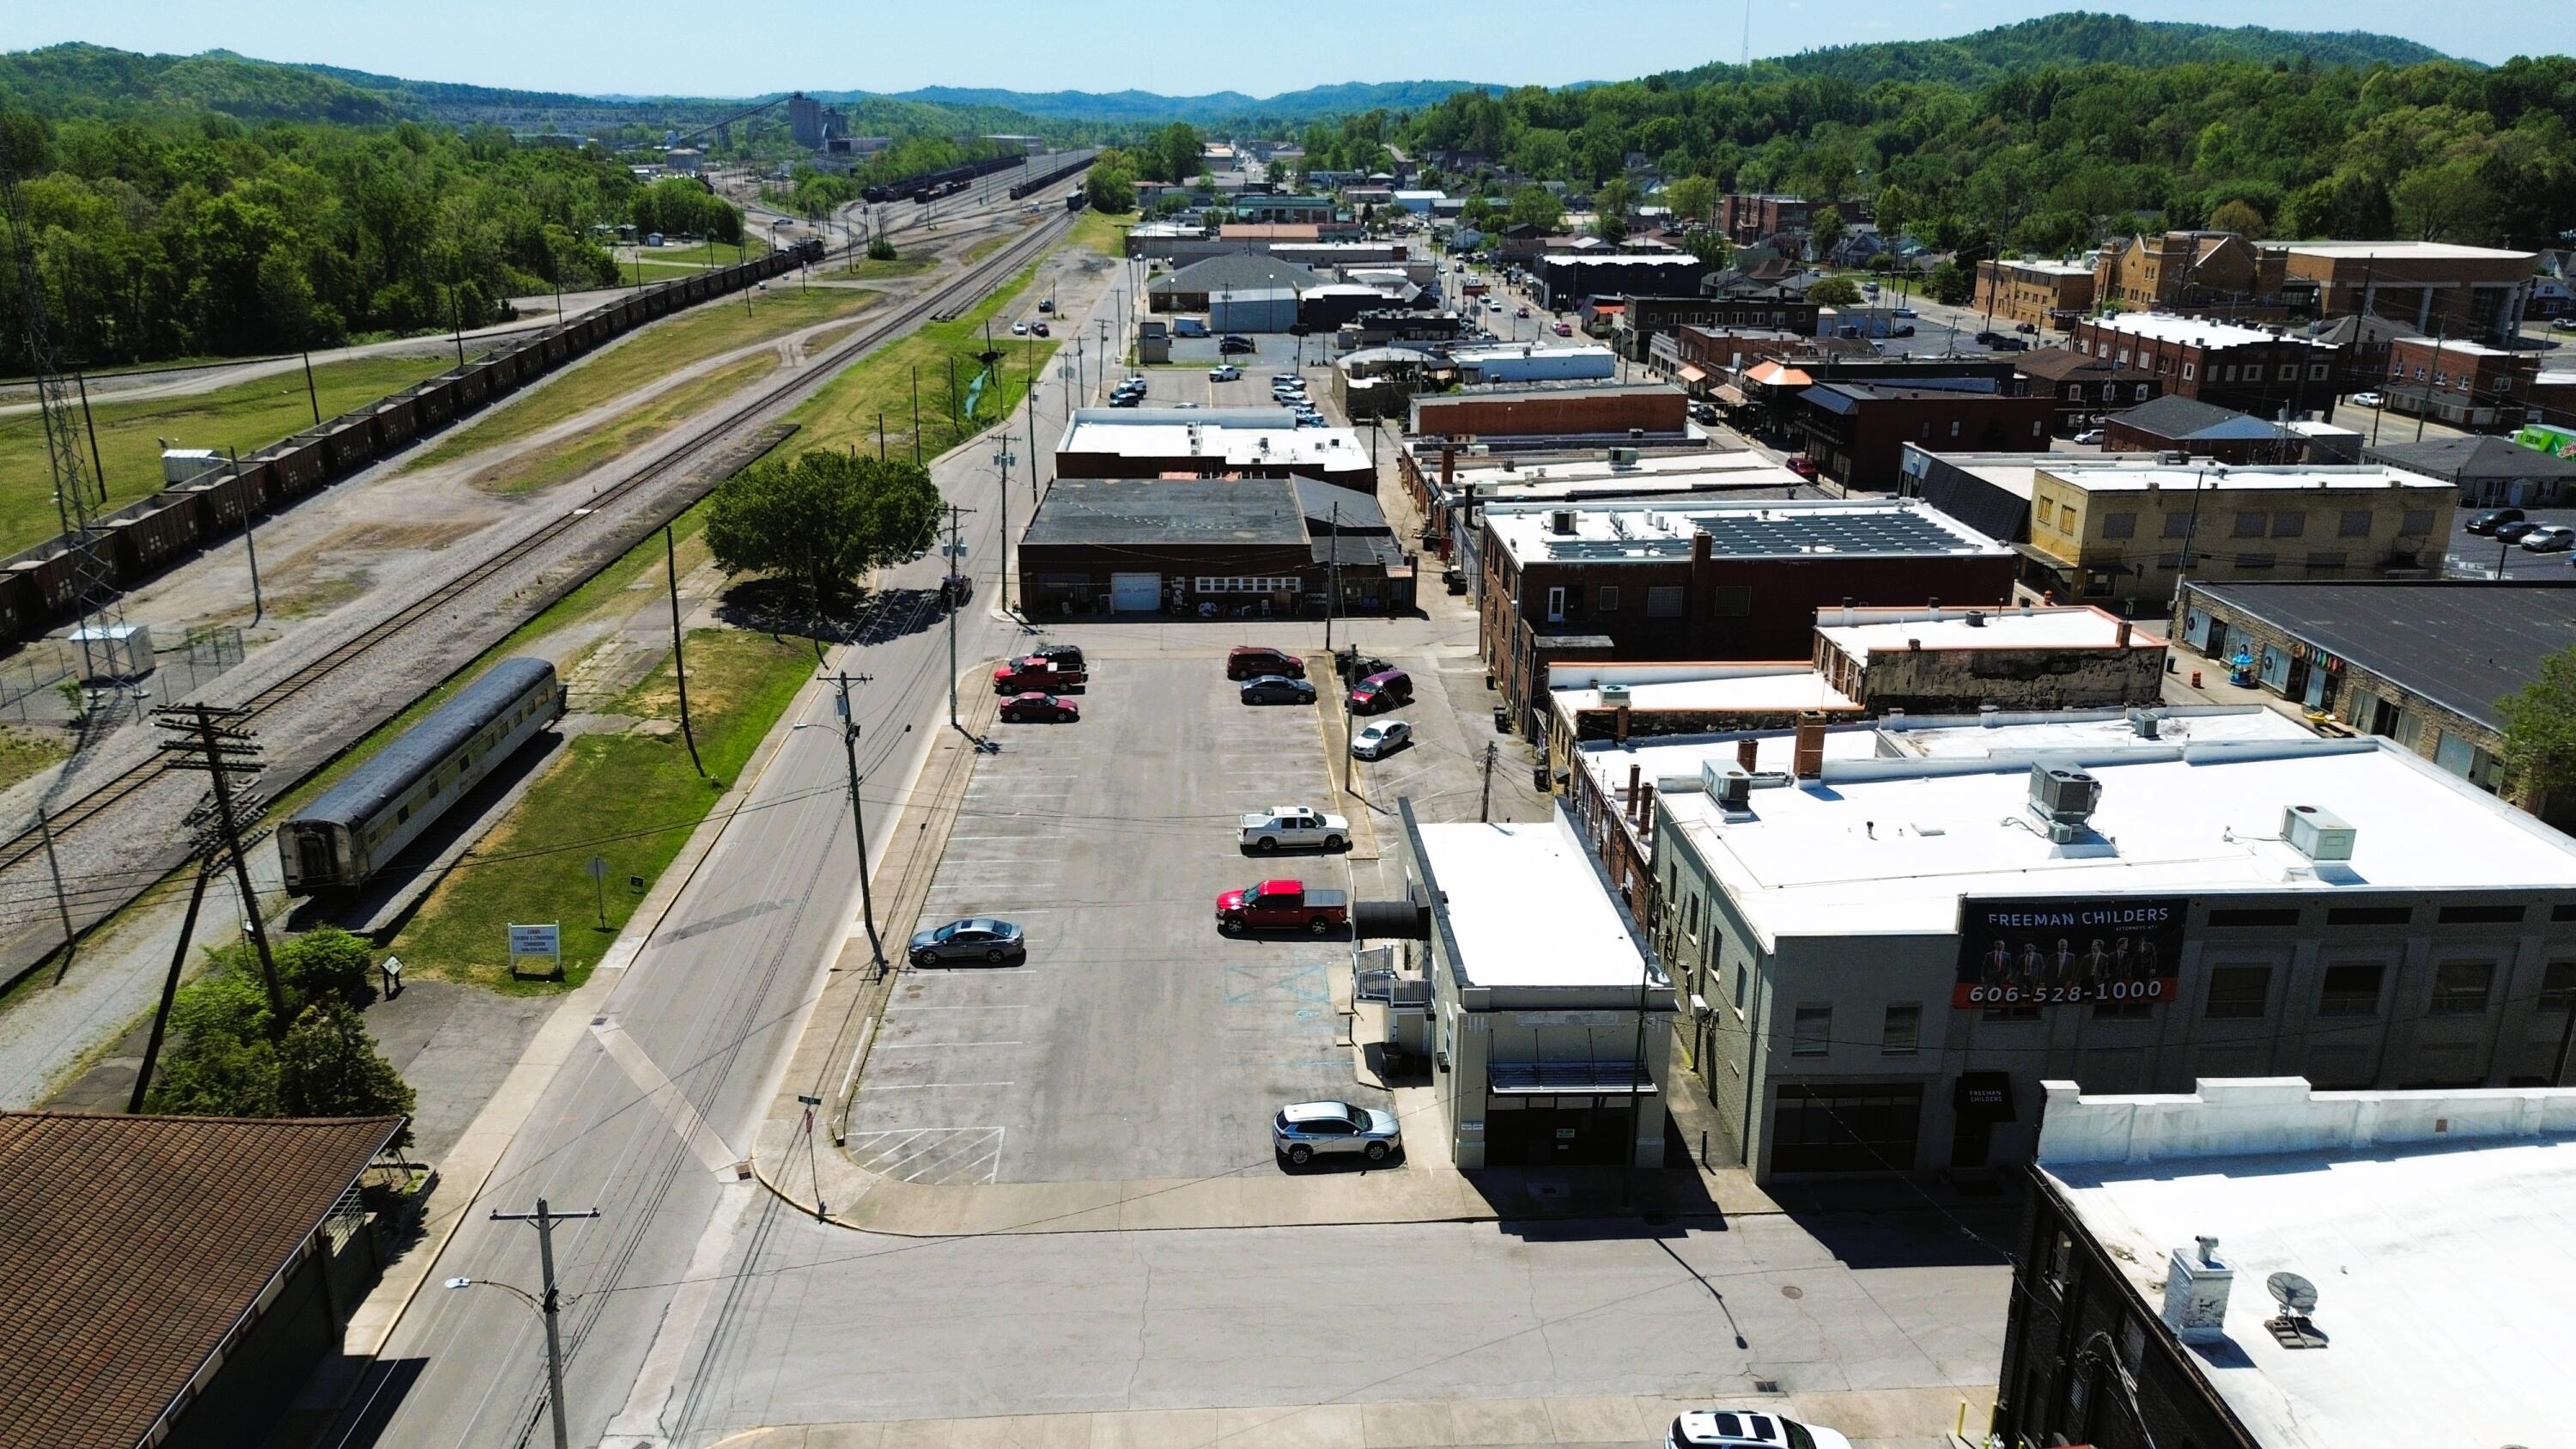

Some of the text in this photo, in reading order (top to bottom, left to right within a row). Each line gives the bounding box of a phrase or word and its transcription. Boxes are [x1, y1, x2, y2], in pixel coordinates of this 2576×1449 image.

[2525, 435, 2543, 445] DEW
[1988, 907, 2169, 927] FREEMAN CHILDERS
[1969, 980, 2162, 1002] 606-528-1000
